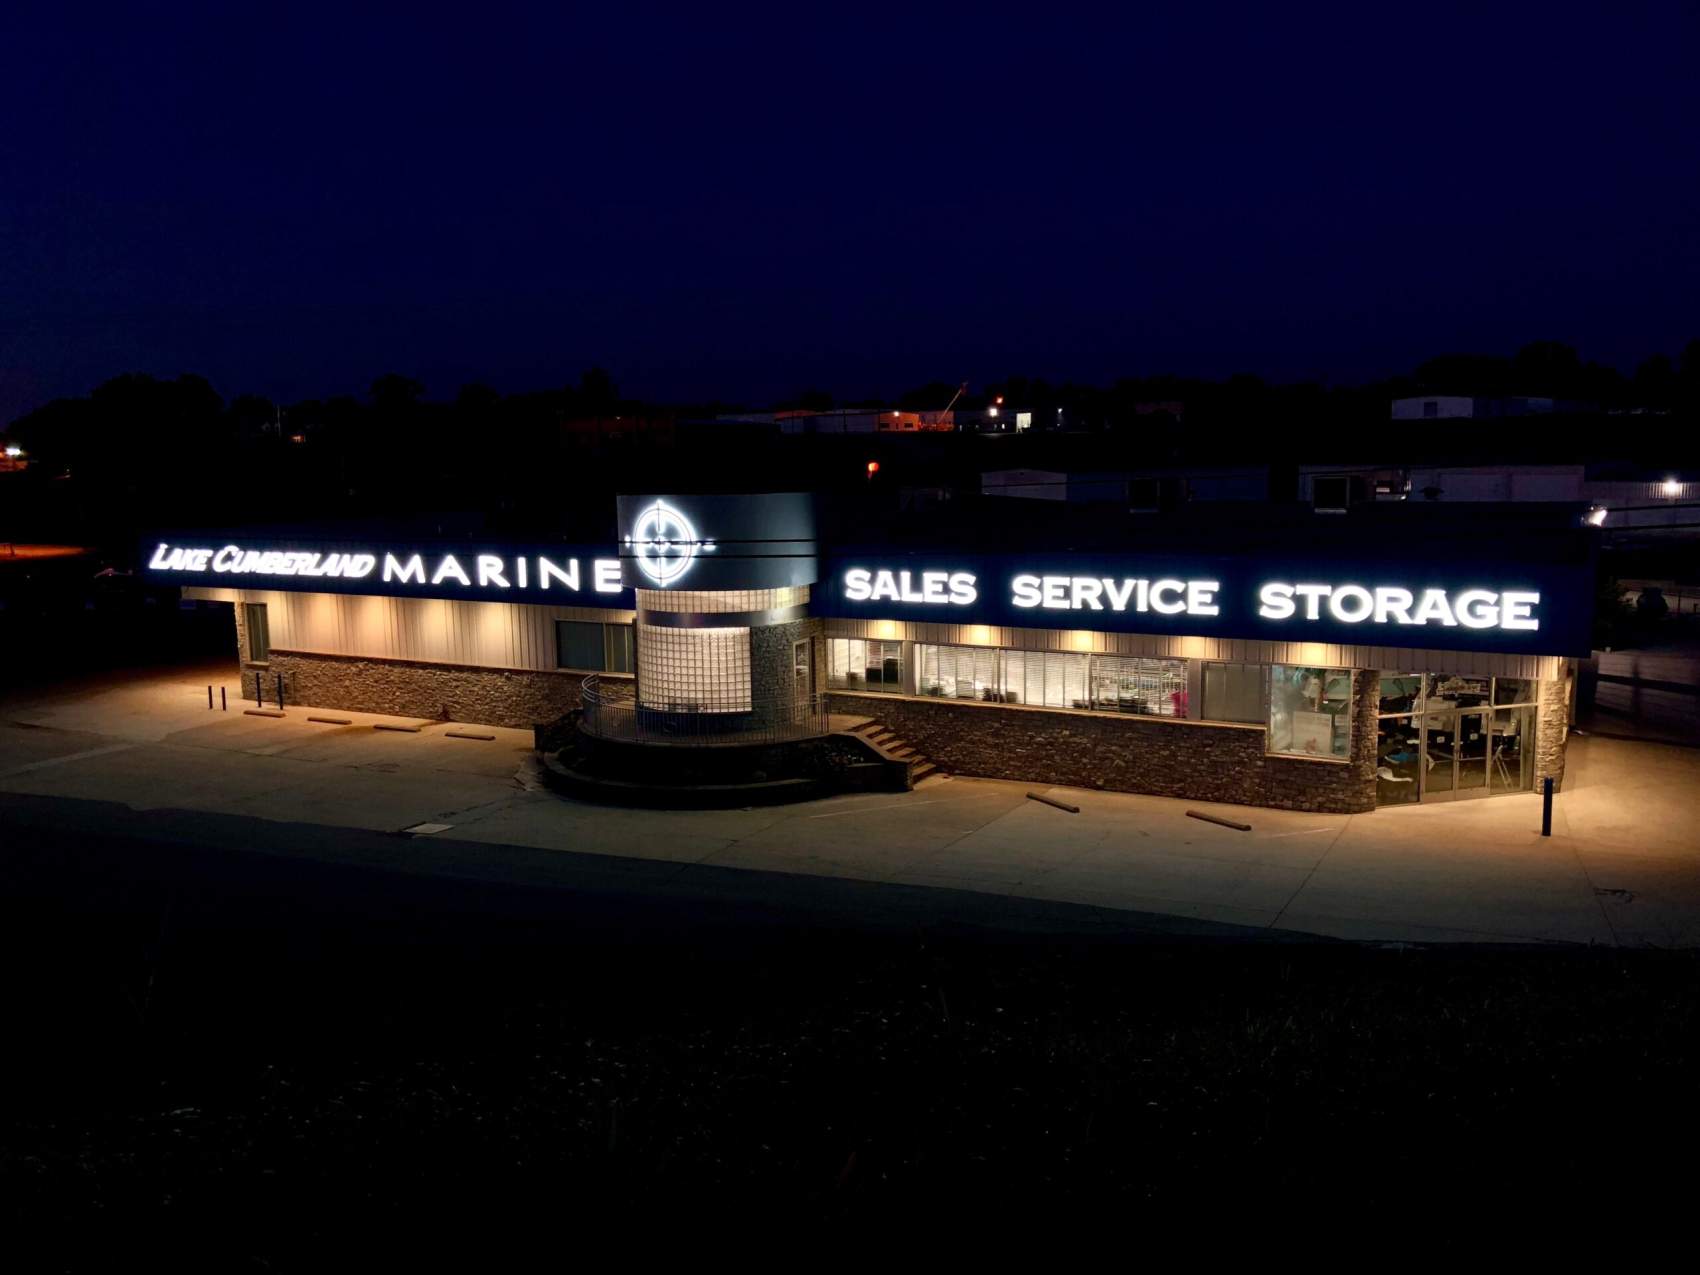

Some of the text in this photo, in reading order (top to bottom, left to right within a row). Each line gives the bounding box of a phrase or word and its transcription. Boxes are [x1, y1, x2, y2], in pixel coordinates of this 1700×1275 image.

[149, 543, 214, 571] LAKE
[382, 552, 623, 593] MARINE
[845, 569, 1541, 630] SALES SERVICE STORAGE
